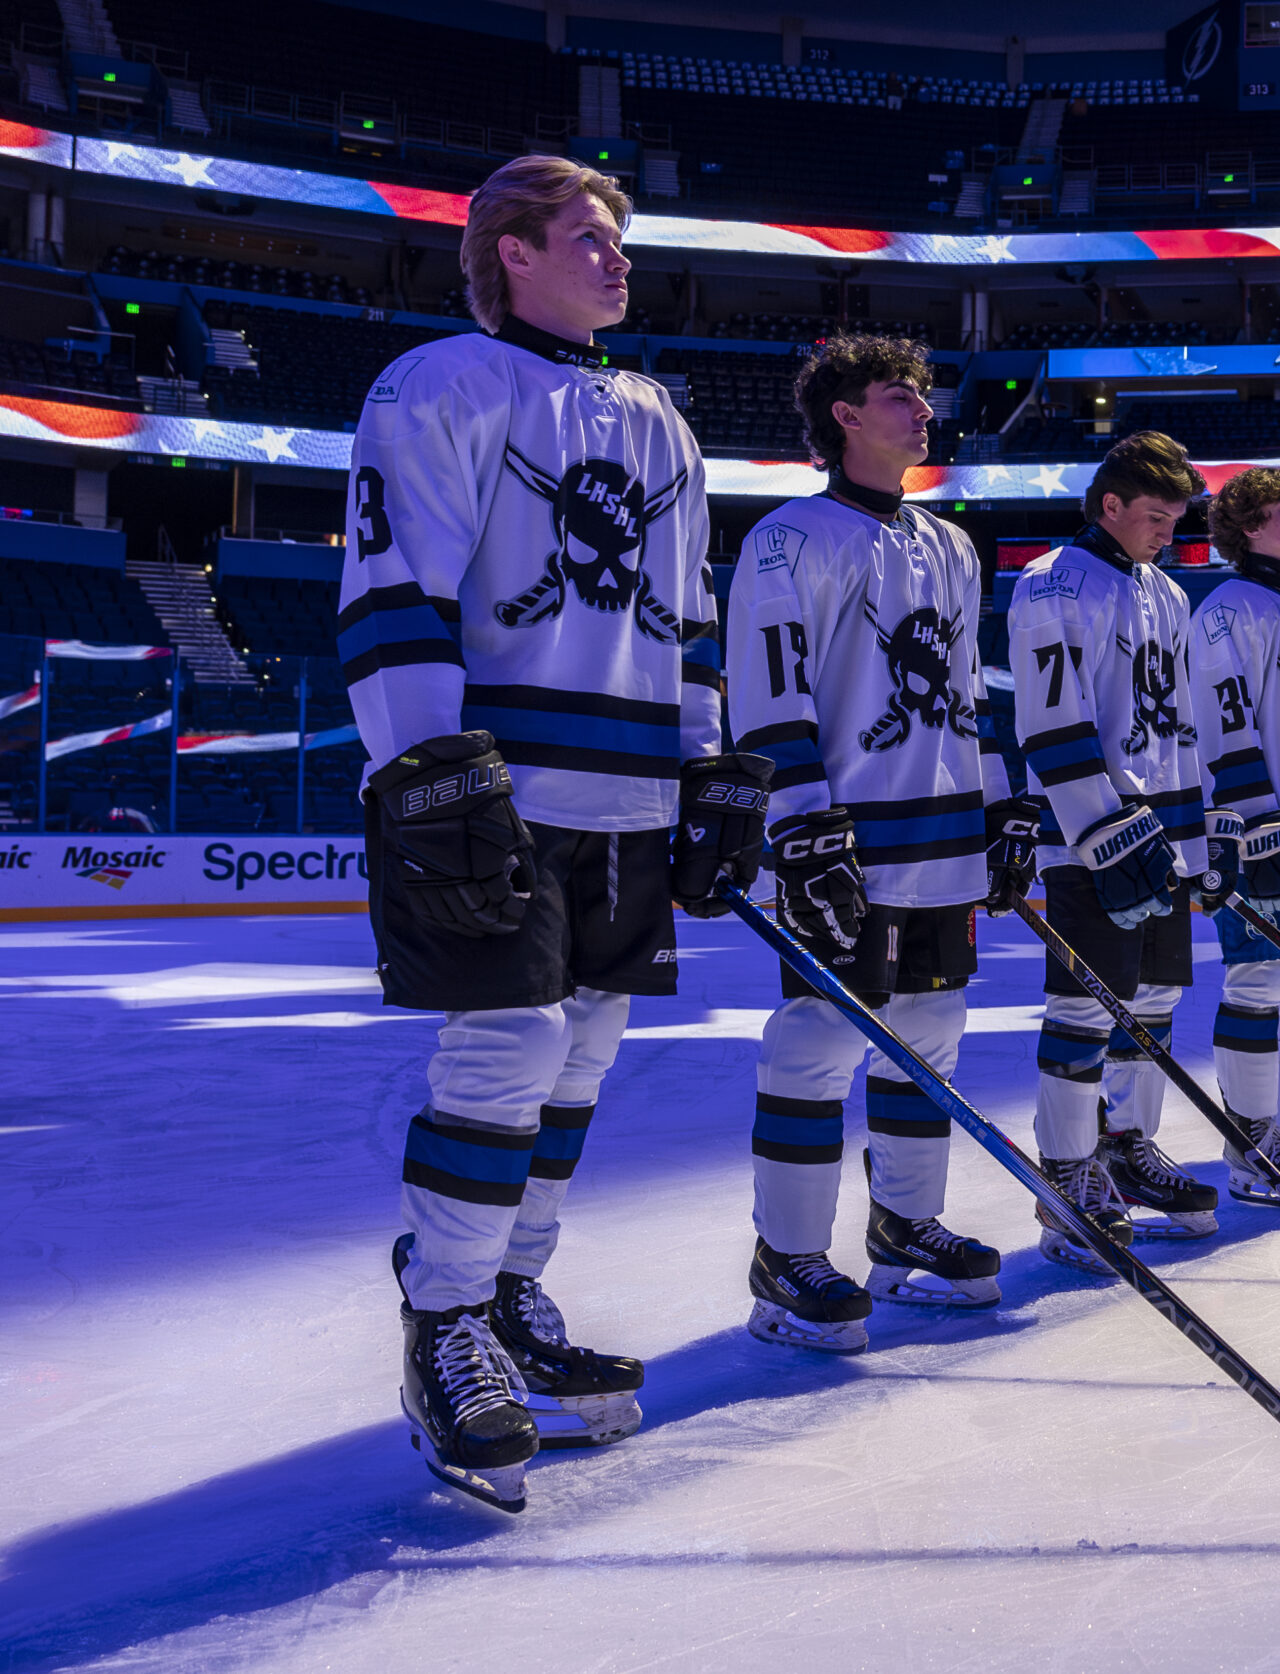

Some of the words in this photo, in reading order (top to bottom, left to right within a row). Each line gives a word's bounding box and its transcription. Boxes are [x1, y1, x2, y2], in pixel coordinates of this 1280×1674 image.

[810, 48, 829, 60] 312
[1250, 84, 1268, 96] 313
[369, 310, 385, 322] 211
[575, 472, 638, 538] LHSHL
[759, 547, 797, 569] HON
[1033, 583, 1076, 599] HONDA
[402, 761, 511, 817] BAUE
[698, 780, 768, 812] BAU
[1093, 812, 1157, 866] WARRI
[62, 844, 166, 868] Mosaic
[202, 841, 369, 891] Spectru
[1083, 969, 1136, 1029] TACKS
[898, 1057, 988, 1141] HYPERLITE
